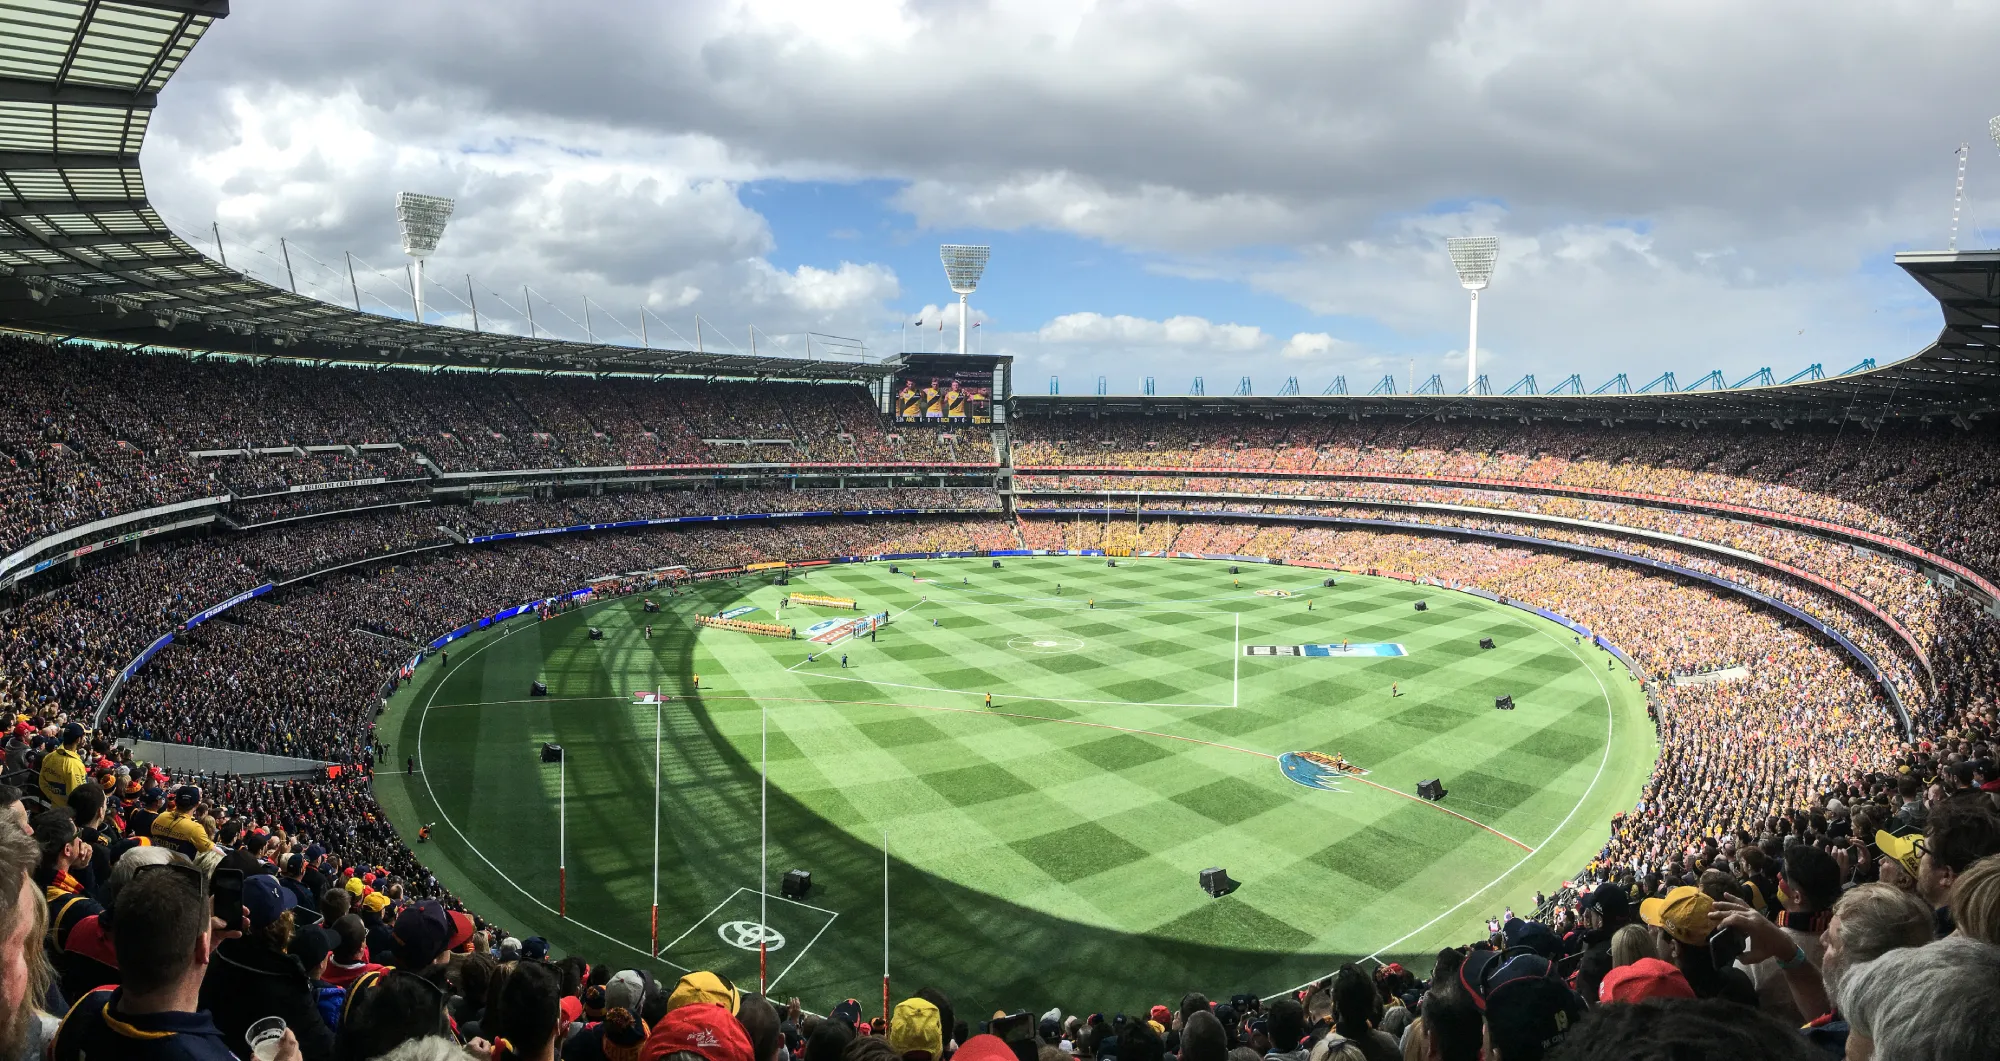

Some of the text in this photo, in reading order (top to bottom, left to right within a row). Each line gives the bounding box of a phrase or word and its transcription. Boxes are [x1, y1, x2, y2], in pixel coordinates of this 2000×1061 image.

[961, 296, 967, 304] 2
[1471, 292, 1477, 301] 3
[304, 482, 334, 491] MELBOURNE
[1554, 1009, 1568, 1031] 19
